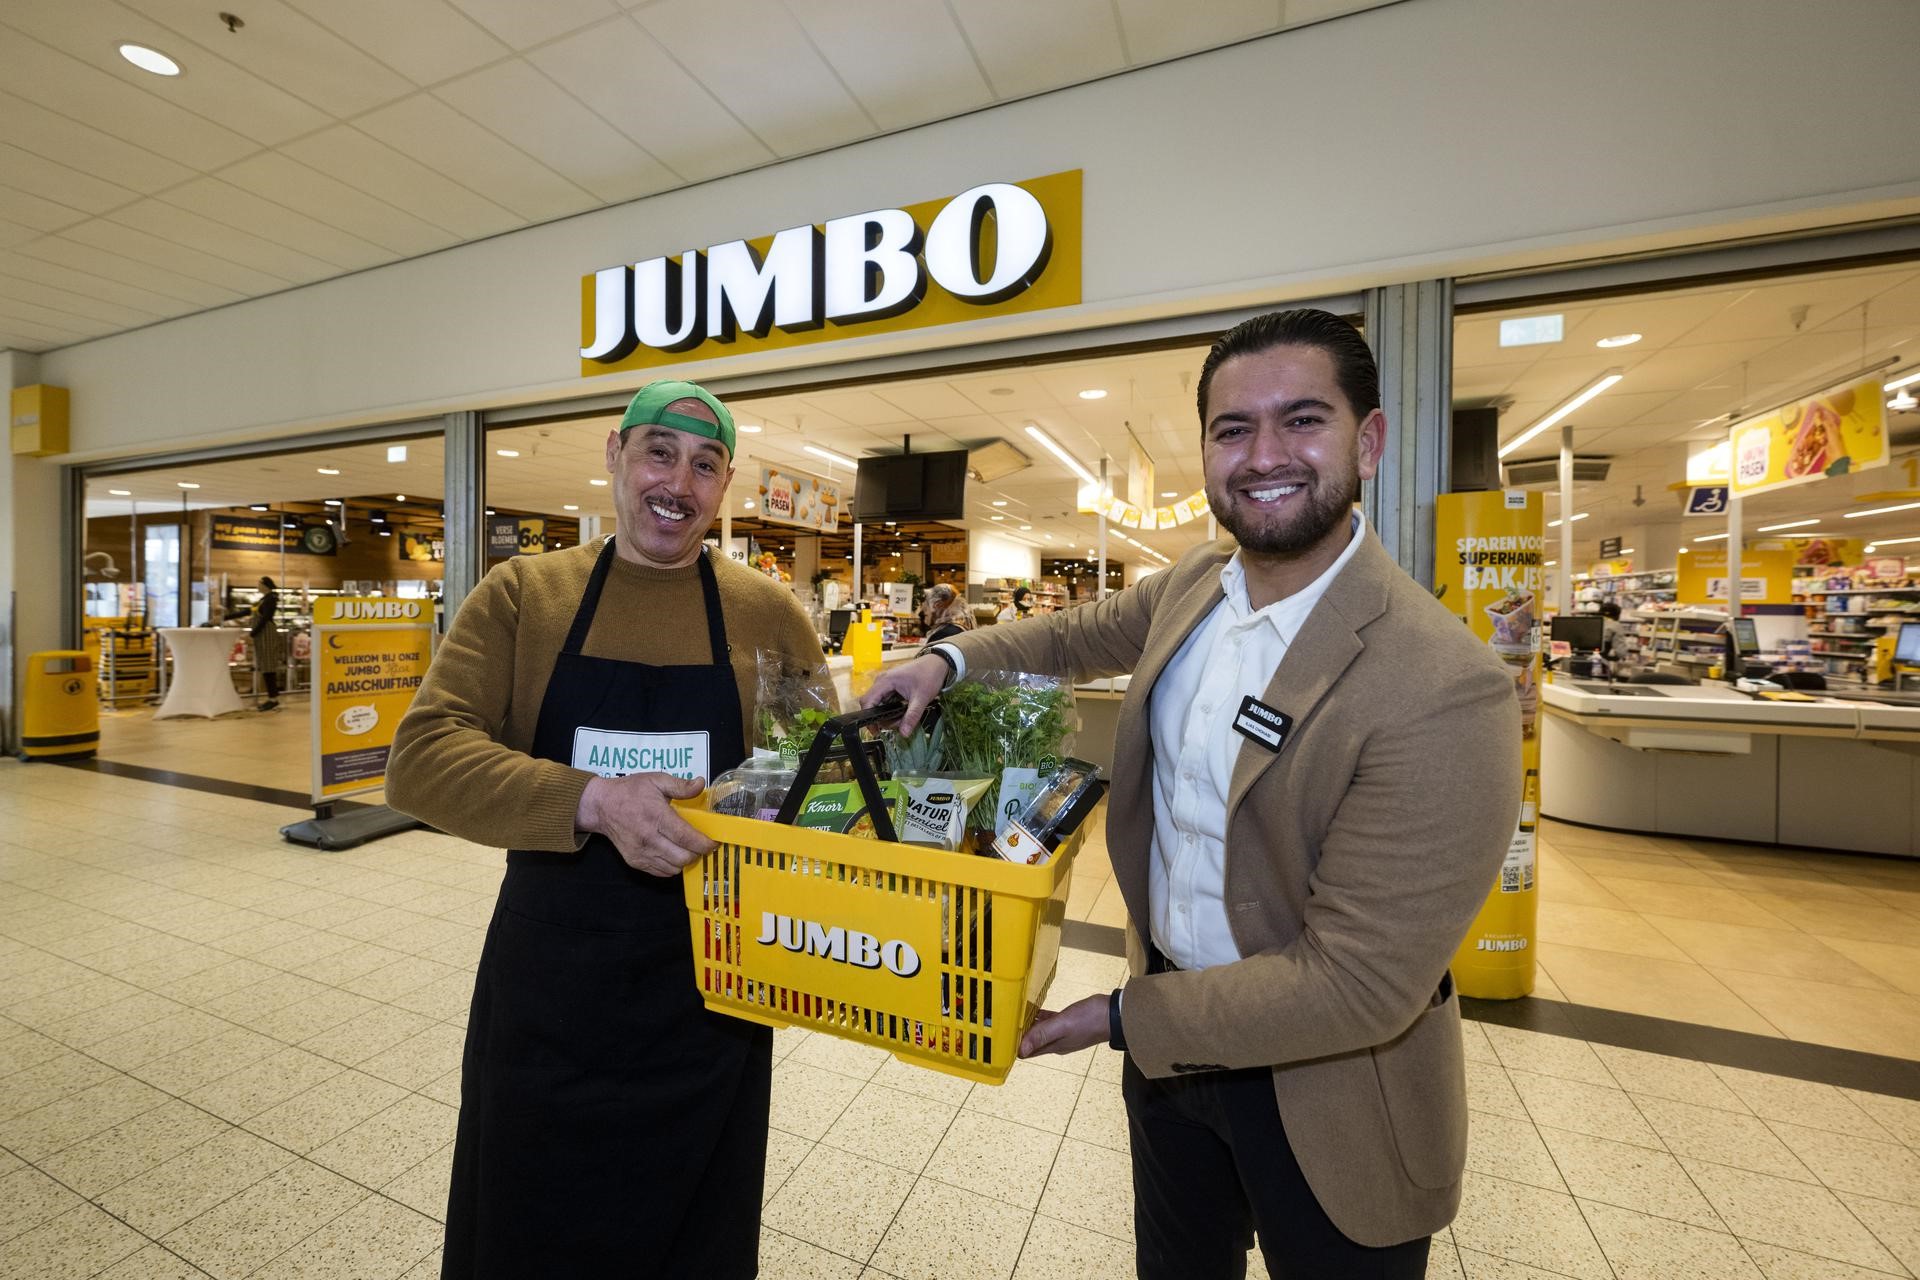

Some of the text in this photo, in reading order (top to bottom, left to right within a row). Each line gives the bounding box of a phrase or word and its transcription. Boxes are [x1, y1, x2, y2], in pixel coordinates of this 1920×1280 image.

[579, 182, 1052, 363] JUMBO
[770, 498, 790, 512] PASEN
[495, 525, 513, 535] VERSE
[491, 535, 518, 546] BLOEMEN
[1456, 536, 1517, 552] SPAREN
[332, 601, 421, 620] JUMBO
[382, 653, 396, 662] BIJ
[398, 652, 421, 661] ONZE
[344, 665, 381, 676] JUMBO
[1247, 703, 1283, 726] JUMBO
[588, 745, 694, 769] AANSCHUIF
[782, 747, 797, 756] BIO
[1041, 761, 1055, 770] BIO
[807, 800, 844, 814] Knorr
[756, 911, 922, 978] JUMBO
[1477, 938, 1528, 952] JUMBO
